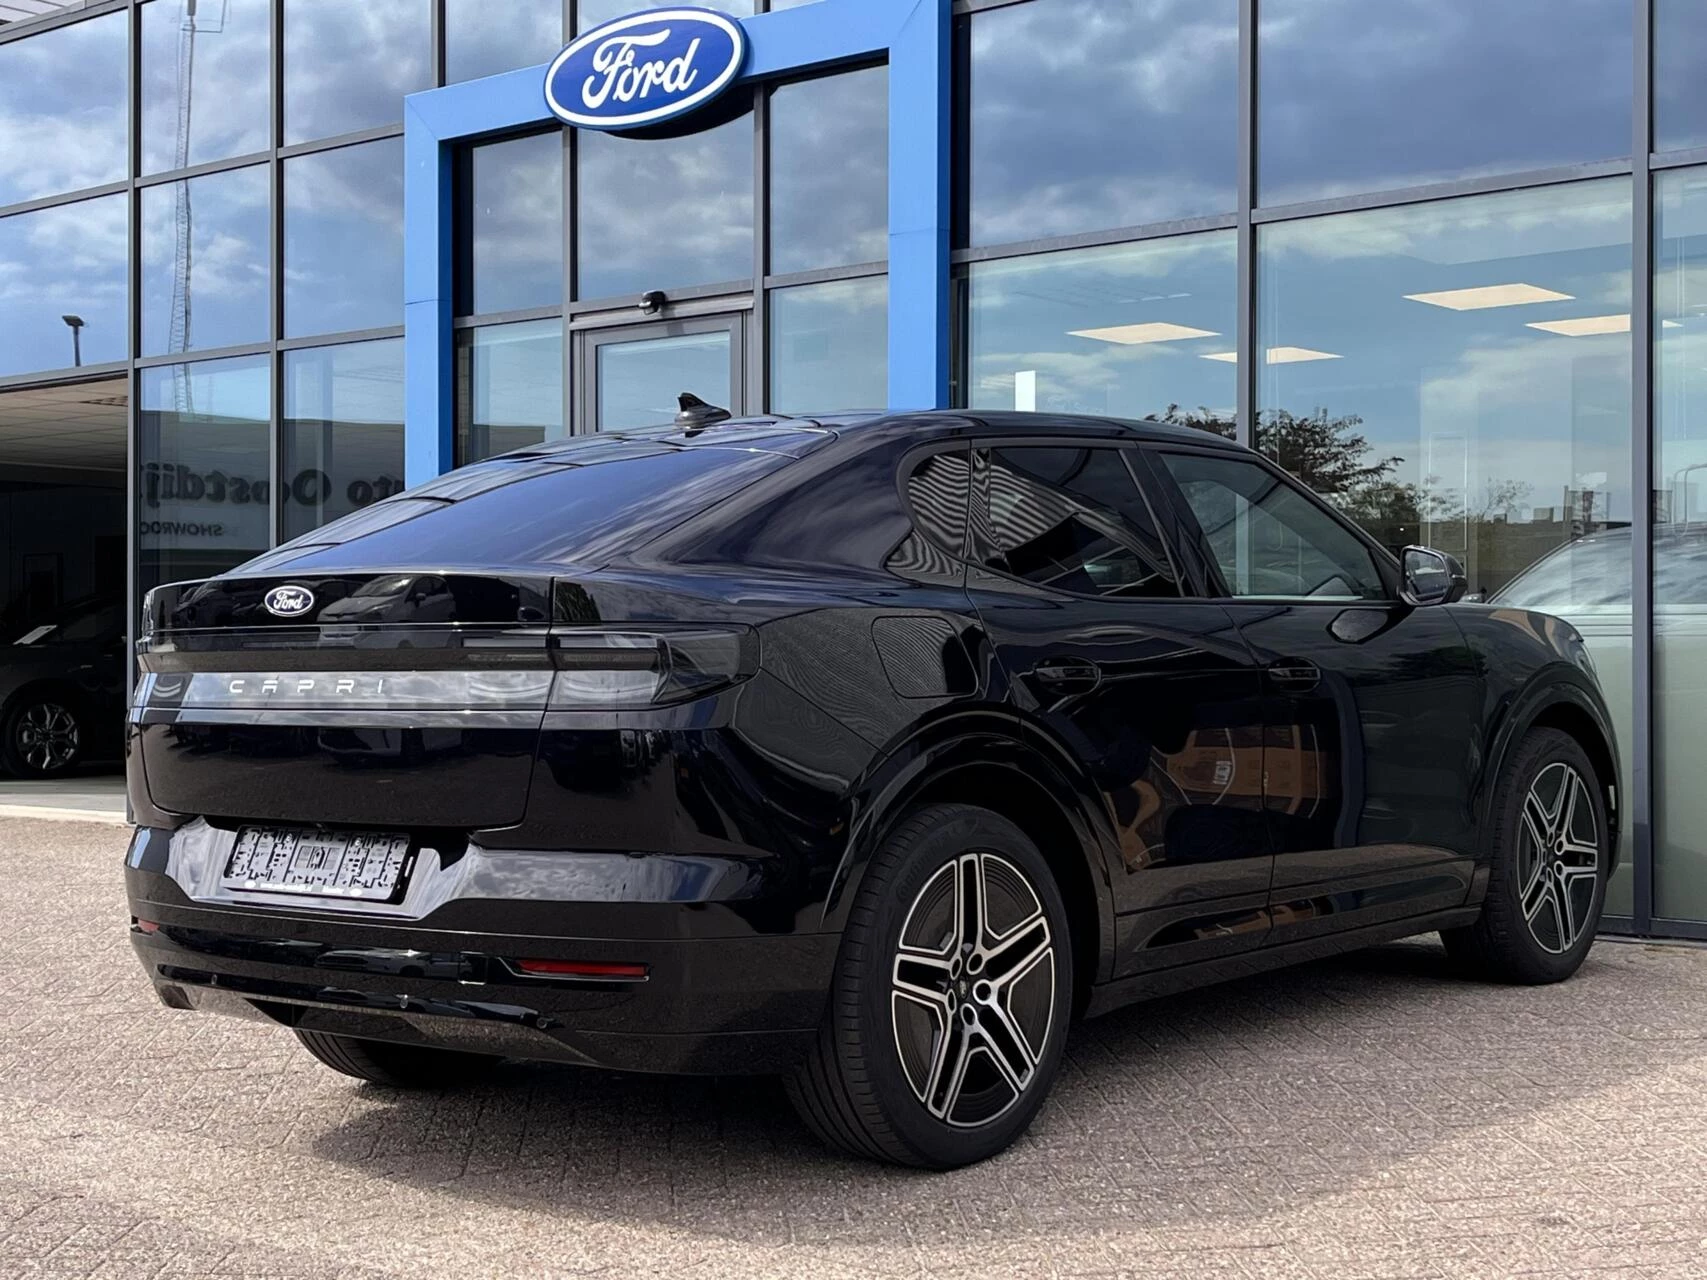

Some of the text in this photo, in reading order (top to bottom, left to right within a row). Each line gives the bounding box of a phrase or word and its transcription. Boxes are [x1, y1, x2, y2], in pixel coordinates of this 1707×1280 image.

[582, 29, 701, 109] Ford
[273, 590, 304, 610] Ford
[229, 679, 384, 694] CAPRI
